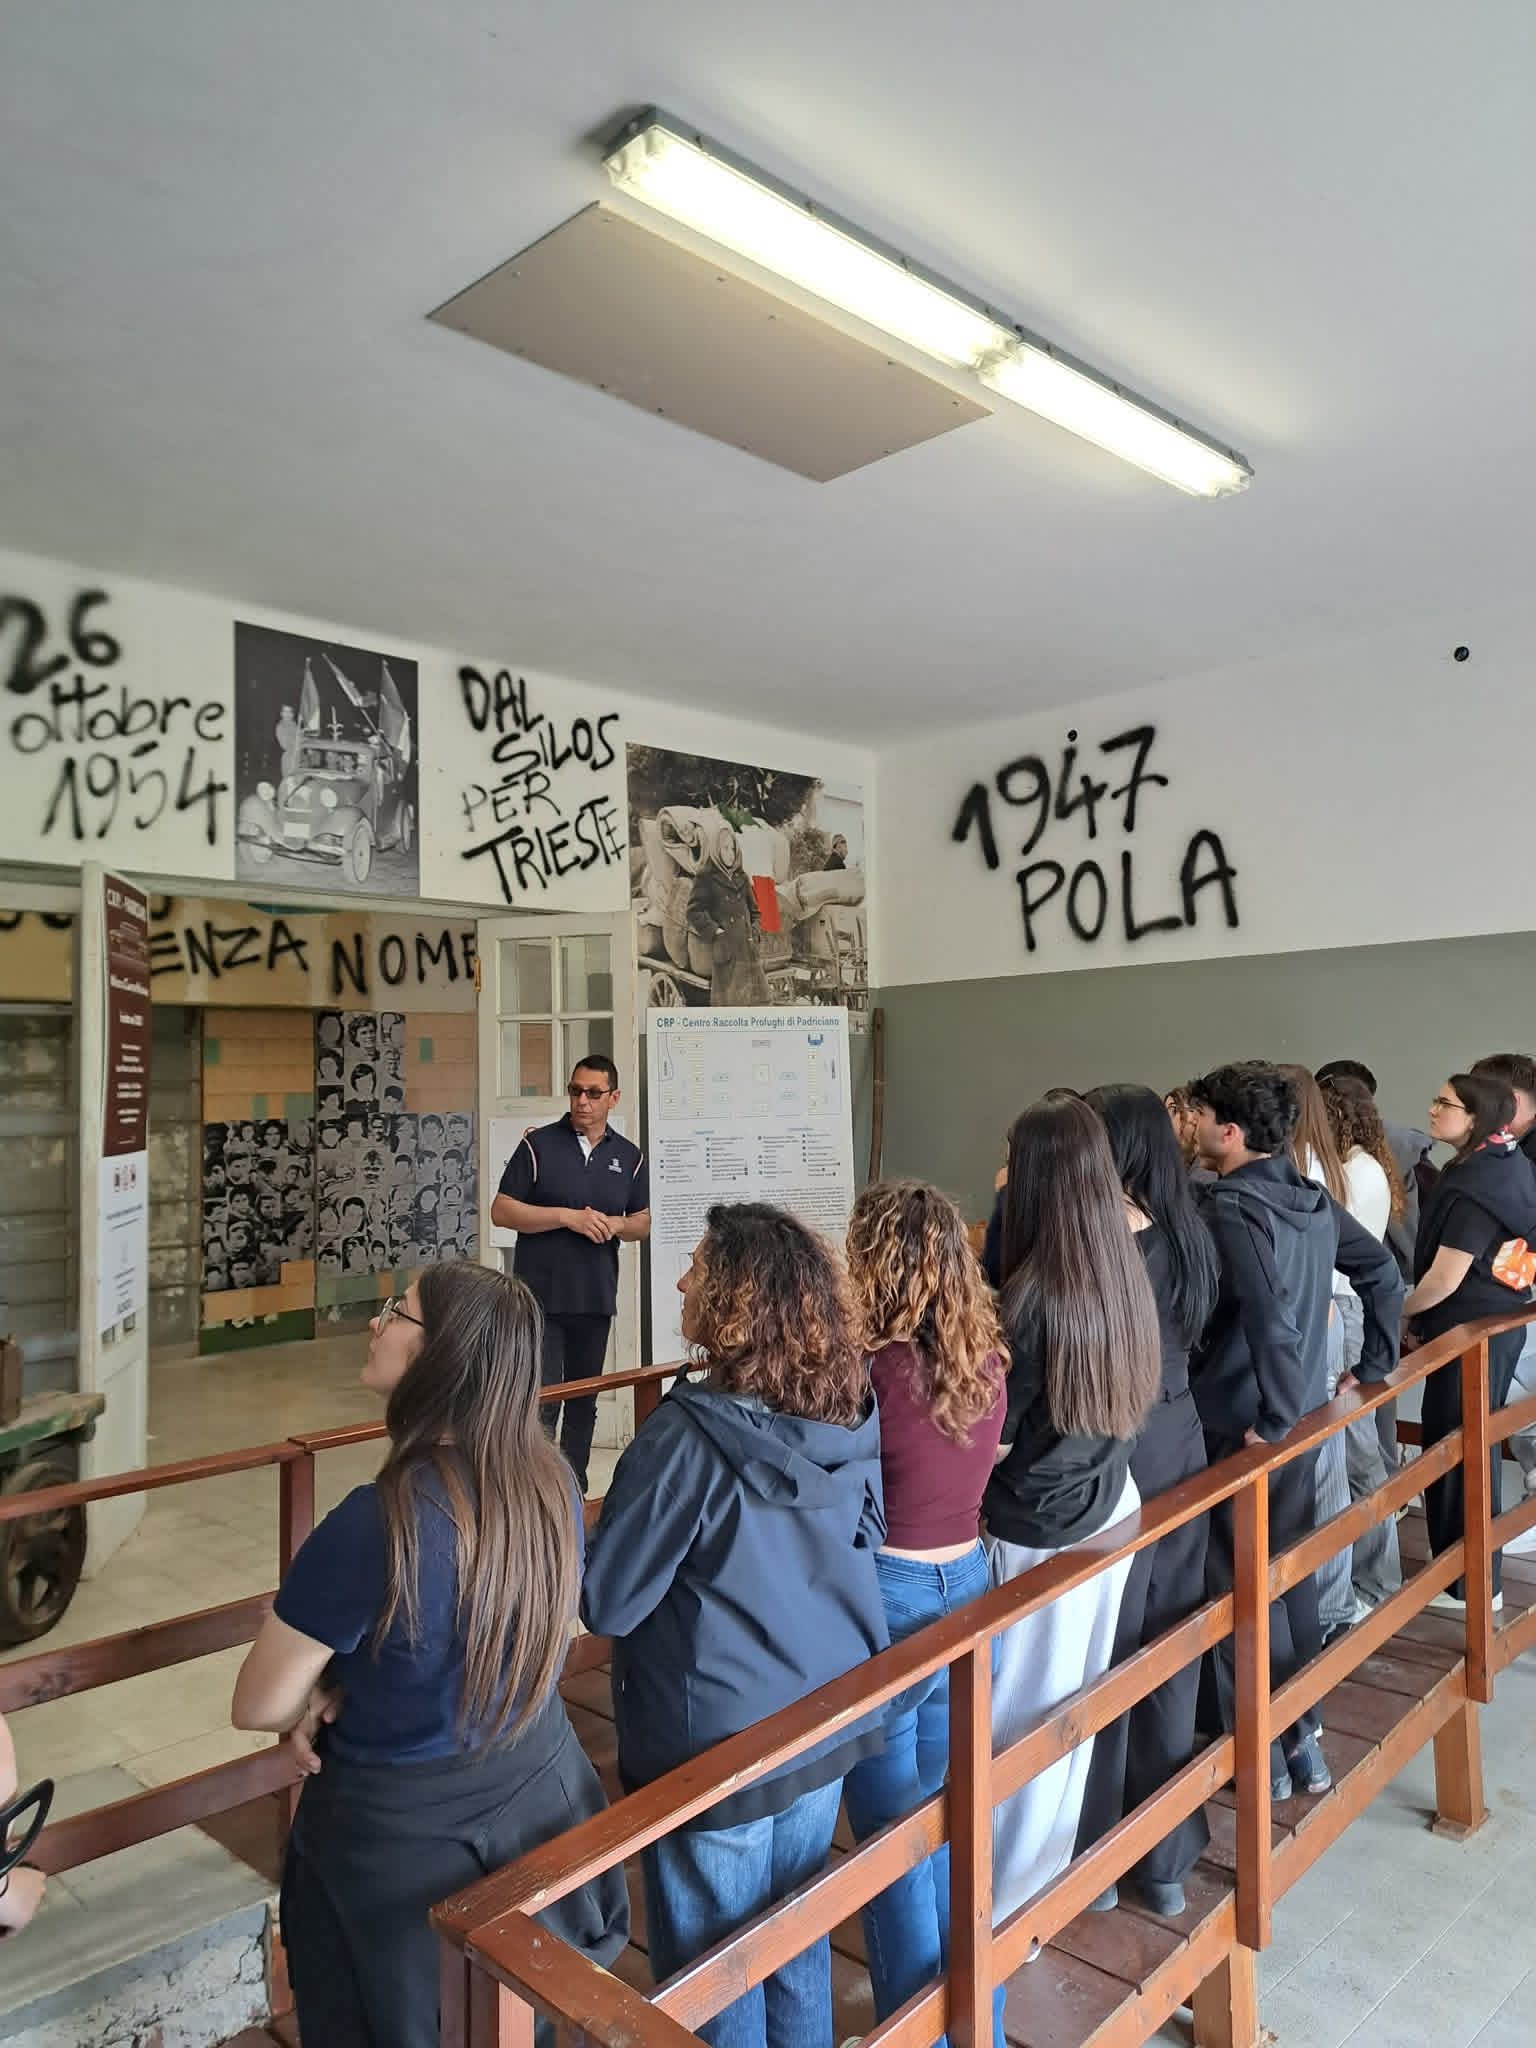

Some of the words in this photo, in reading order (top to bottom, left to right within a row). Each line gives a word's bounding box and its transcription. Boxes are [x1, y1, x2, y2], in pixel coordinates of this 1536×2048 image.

[0, 590, 122, 695] 26
[10, 674, 226, 754] ottobre
[458, 665, 545, 733] DAL
[41, 740, 229, 847] 1954
[491, 712, 620, 783] SILOS
[461, 770, 562, 832] PER
[951, 725, 1169, 870] 1947
[460, 795, 628, 905] TRIESTE
[1015, 828, 1240, 952] POLA
[656, 1017, 675, 1028] CRP
[681, 1017, 711, 1028] Centro
[713, 1016, 749, 1027] Raccolta
[751, 1016, 785, 1029] Profughi
[787, 1016, 795, 1026] di
[797, 1015, 840, 1026] Padriciano
